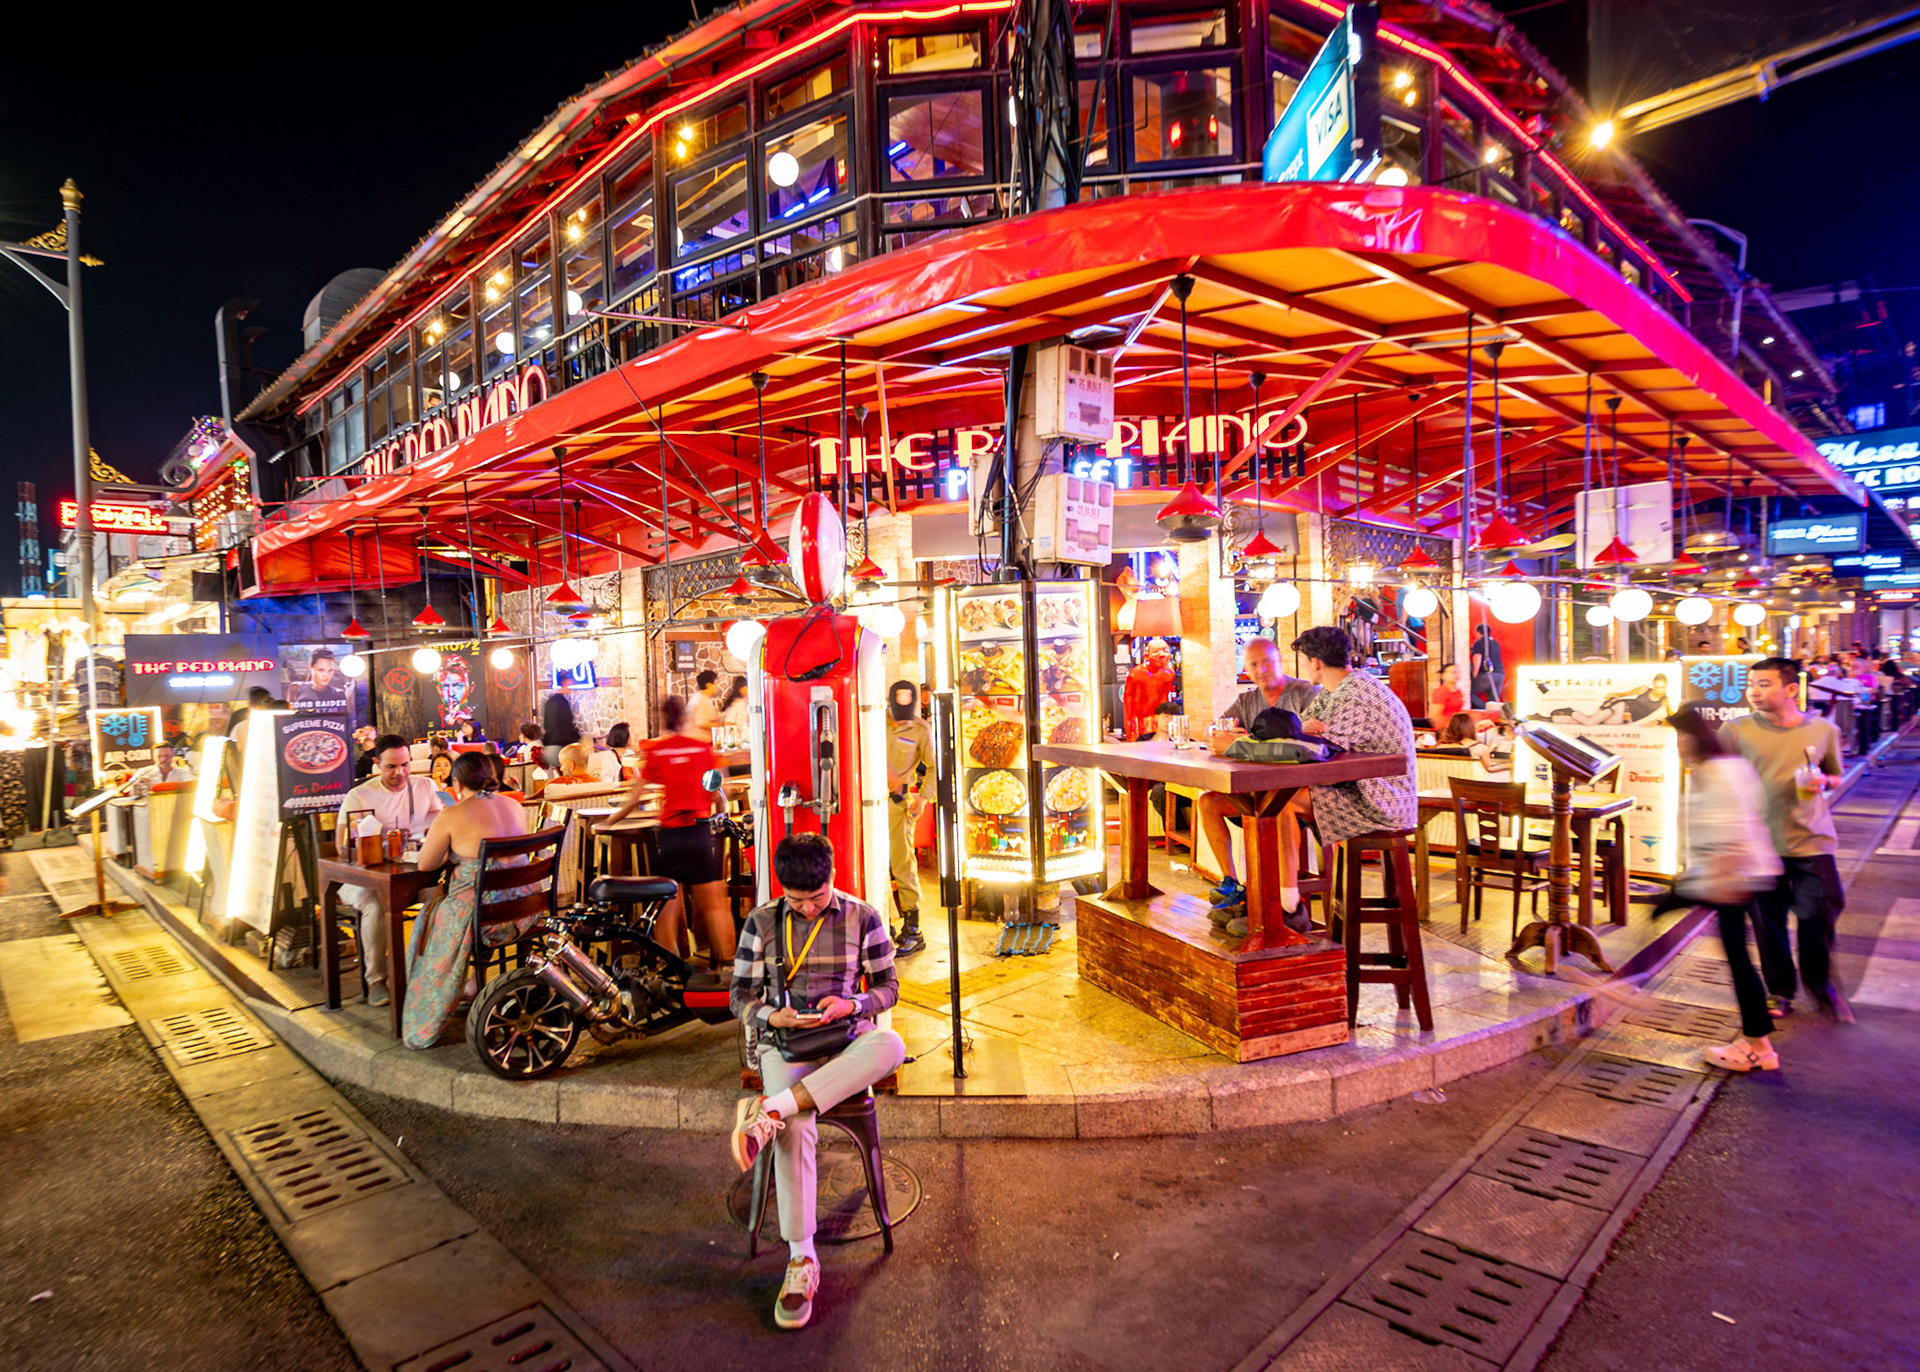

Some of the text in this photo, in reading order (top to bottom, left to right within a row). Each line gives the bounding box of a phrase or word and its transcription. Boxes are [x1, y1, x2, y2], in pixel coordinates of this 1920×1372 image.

[1314, 92, 1342, 145] VISA
[810, 432, 936, 475] THE
[1101, 410, 1308, 458] PIANO
[131, 661, 173, 675] THE
[217, 659, 275, 672] PIANO
[1566, 678, 1613, 687] RAIDER
[315, 700, 347, 708] RAIDER
[282, 719, 345, 734] SUPREME PIZZA
[104, 748, 152, 763] AIR-CON
